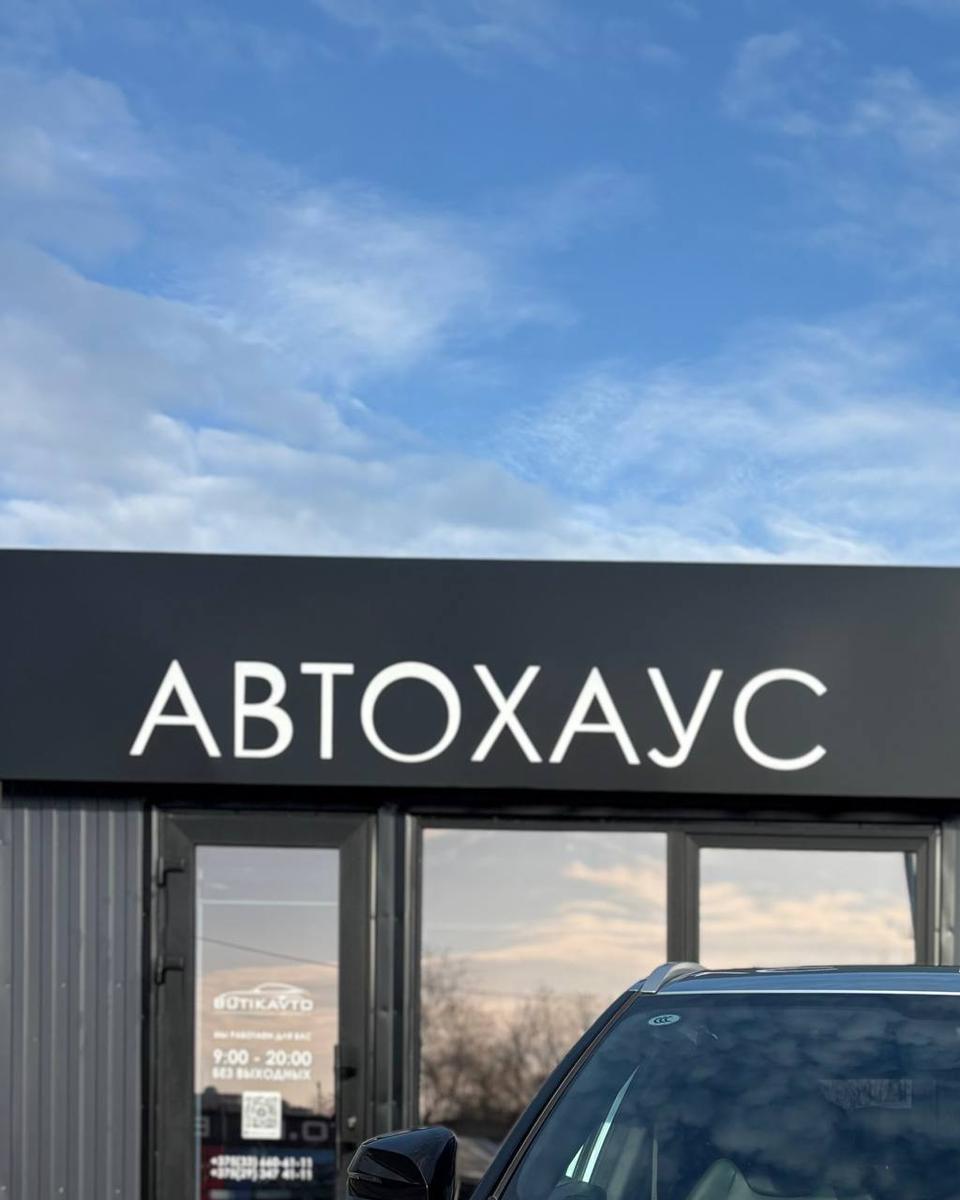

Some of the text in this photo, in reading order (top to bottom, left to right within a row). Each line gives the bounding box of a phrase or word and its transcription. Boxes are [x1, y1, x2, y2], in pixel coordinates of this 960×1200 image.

[130, 659, 828, 771] АВТОХАУС
[213, 997, 313, 1011] BUTIKAVTO
[212, 1048, 250, 1066] 9:00
[265, 1049, 312, 1067] 20:00
[212, 1067, 311, 1081] БЕЗ ВЫХОДНЫХ
